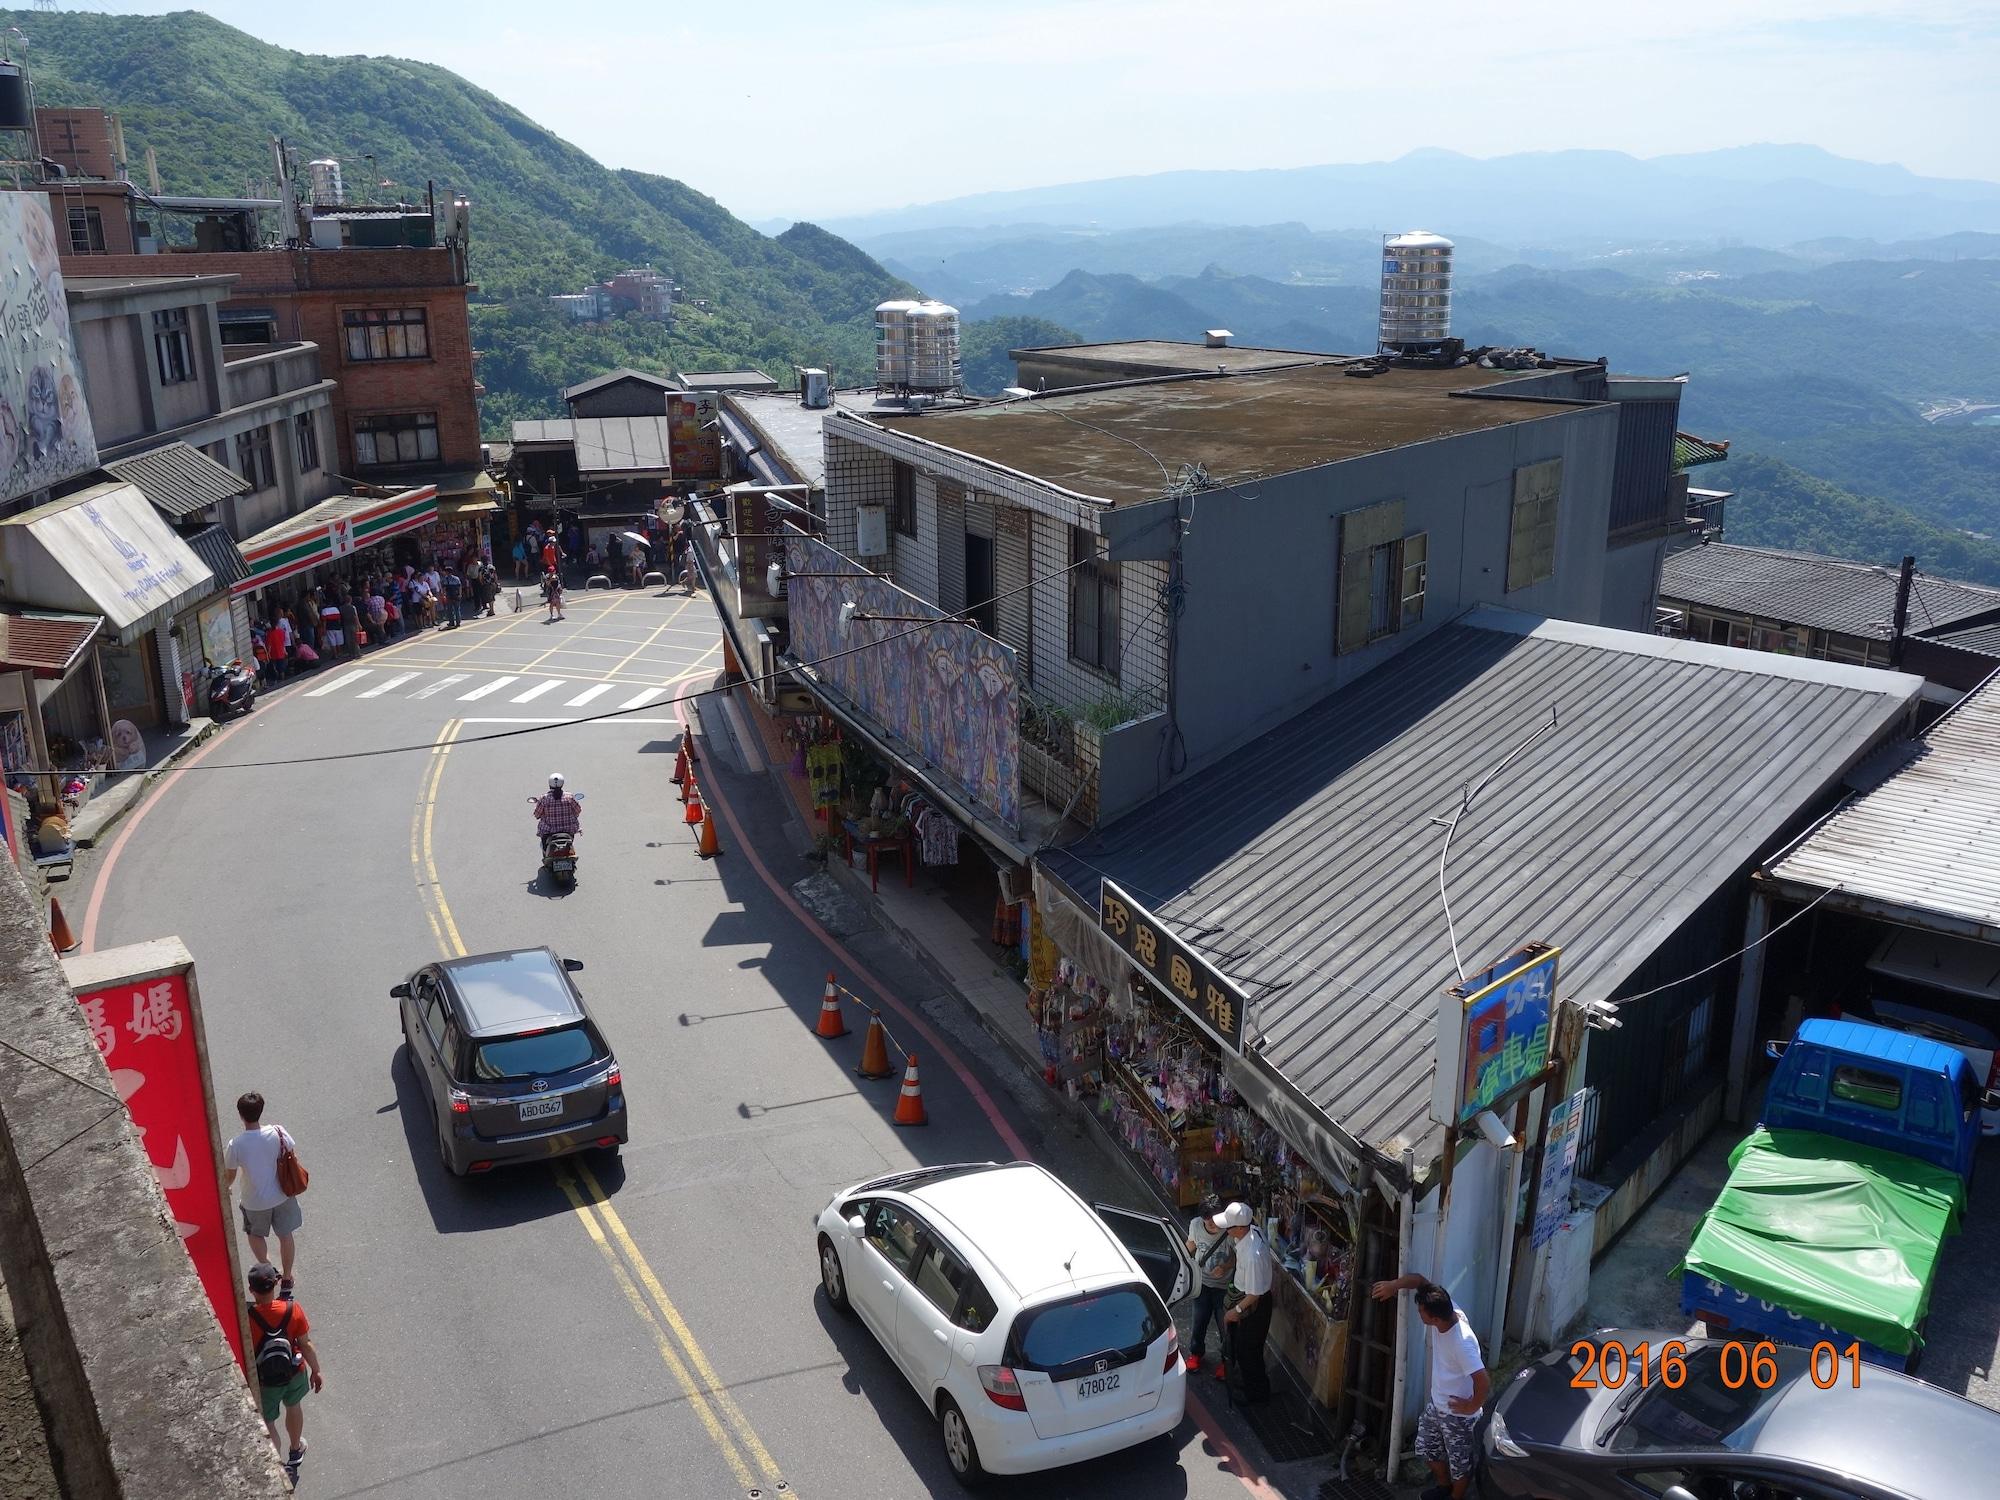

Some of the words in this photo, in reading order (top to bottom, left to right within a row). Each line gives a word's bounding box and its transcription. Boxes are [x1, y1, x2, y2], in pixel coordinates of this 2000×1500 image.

[1478, 1023, 1549, 1106] 停車場
[1078, 1374, 1121, 1398] 4780-22
